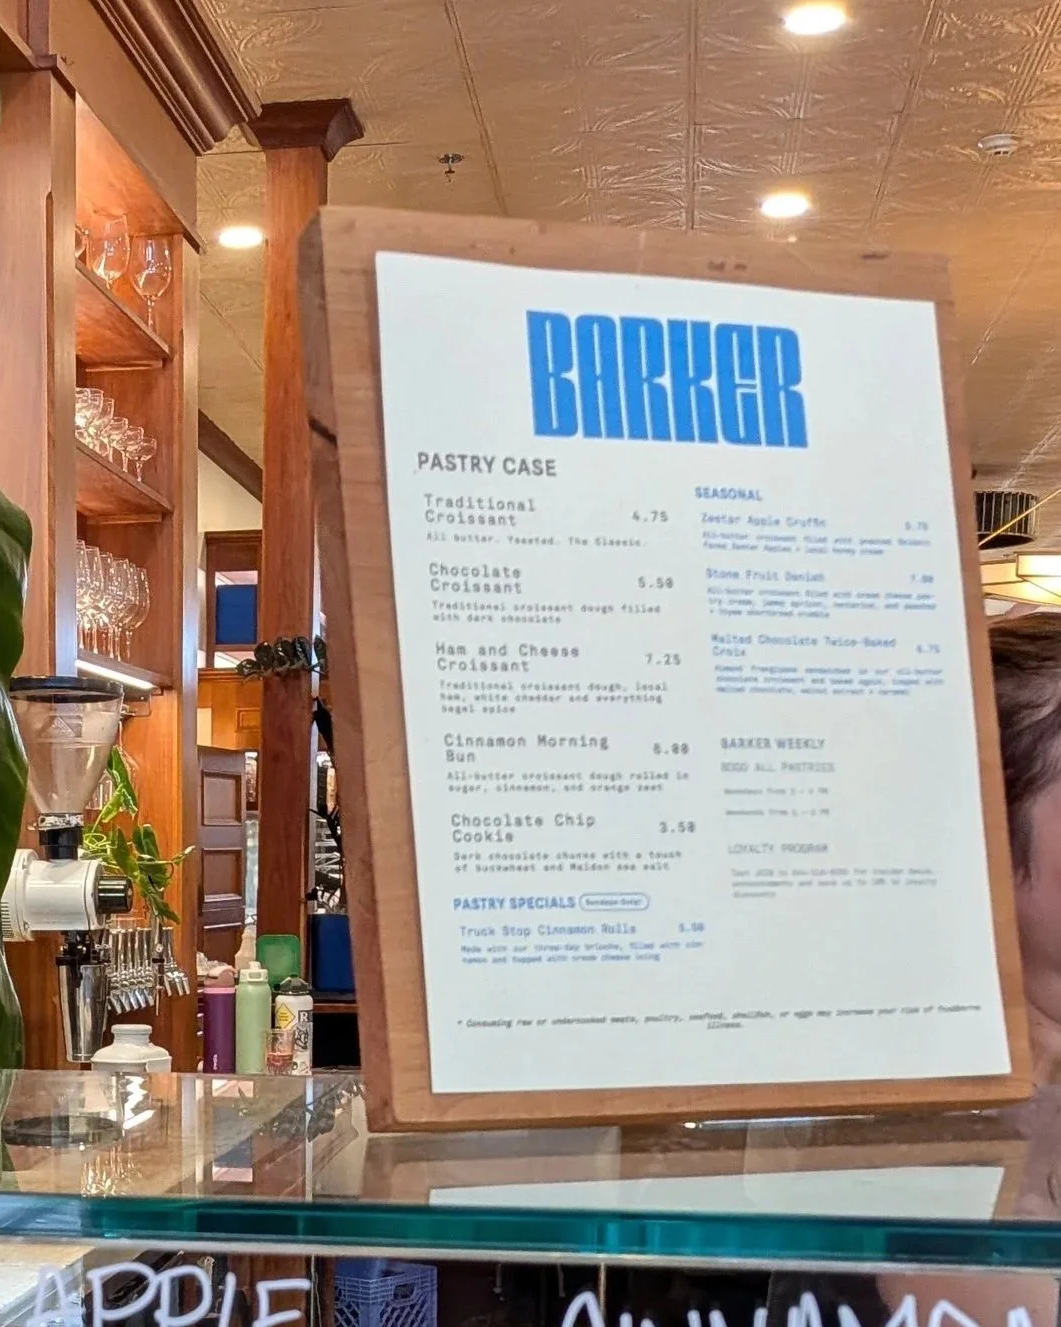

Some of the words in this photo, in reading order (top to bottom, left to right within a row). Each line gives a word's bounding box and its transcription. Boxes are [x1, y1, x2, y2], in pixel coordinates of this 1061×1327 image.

[526, 310, 809, 449] BARKER
[417, 453, 495, 473] PASTRY
[503, 458, 557, 476] CASE
[695, 487, 763, 501] SEASONAL
[424, 494, 537, 512] Traditional
[425, 510, 516, 526] Croissant
[632, 511, 668, 523] 4.75
[748, 516, 780, 527] Apple
[426, 533, 446, 541] All
[569, 537, 587, 546] The
[595, 537, 645, 547] Classic.
[429, 563, 521, 578] Chocolate
[706, 568, 739, 579] Stone
[746, 570, 778, 580] Fruit
[785, 571, 824, 582] Danish
[431, 579, 522, 594] Croissant
[638, 577, 674, 589] 5.50
[433, 601, 505, 611] Traditional
[514, 603, 573, 612] croissant
[581, 604, 614, 614] dough
[621, 604, 661, 613] filled
[433, 613, 459, 621] with
[467, 614, 493, 622] dark
[501, 614, 561, 623] chocolate
[711, 634, 751, 645] Malted
[758, 635, 818, 646] Chocolate
[436, 642, 466, 656] Ham
[478, 643, 507, 656] and
[519, 644, 579, 657] Cheese
[437, 658, 529, 672] Croissant
[645, 654, 681, 665] 7.25
[440, 680, 513, 690] Traditional
[521, 682, 581, 691] croissant
[635, 682, 668, 691] local
[474, 693, 507, 702] white
[515, 694, 561, 702] cheddar
[569, 694, 588, 702] and
[596, 694, 662, 704] everything
[442, 705, 474, 714] bagel
[483, 705, 515, 713] spice
[444, 734, 526, 747] Cinnamon
[537, 735, 609, 750] Morning
[721, 738, 771, 749] BARKER
[776, 738, 825, 749] WEEKLY
[446, 749, 475, 763] Bun
[754, 763, 776, 772] ALL
[781, 763, 835, 773] PASTRIES
[522, 772, 582, 780] croissant
[589, 772, 622, 782] dough
[630, 772, 669, 780] rolled
[677, 772, 688, 780] in
[590, 784, 630, 793] orange
[451, 814, 543, 827] Chocolate
[554, 814, 595, 828] Chip
[659, 822, 696, 833] 3.50
[452, 830, 513, 843] Cookie
[453, 898, 504, 910] PASTRY
[509, 896, 576, 909] SPECIALS
[460, 926, 496, 937] Truck
[502, 925, 530, 938] Stop
[538, 925, 595, 935] Cinnamon
[601, 924, 636, 934] Rolls
